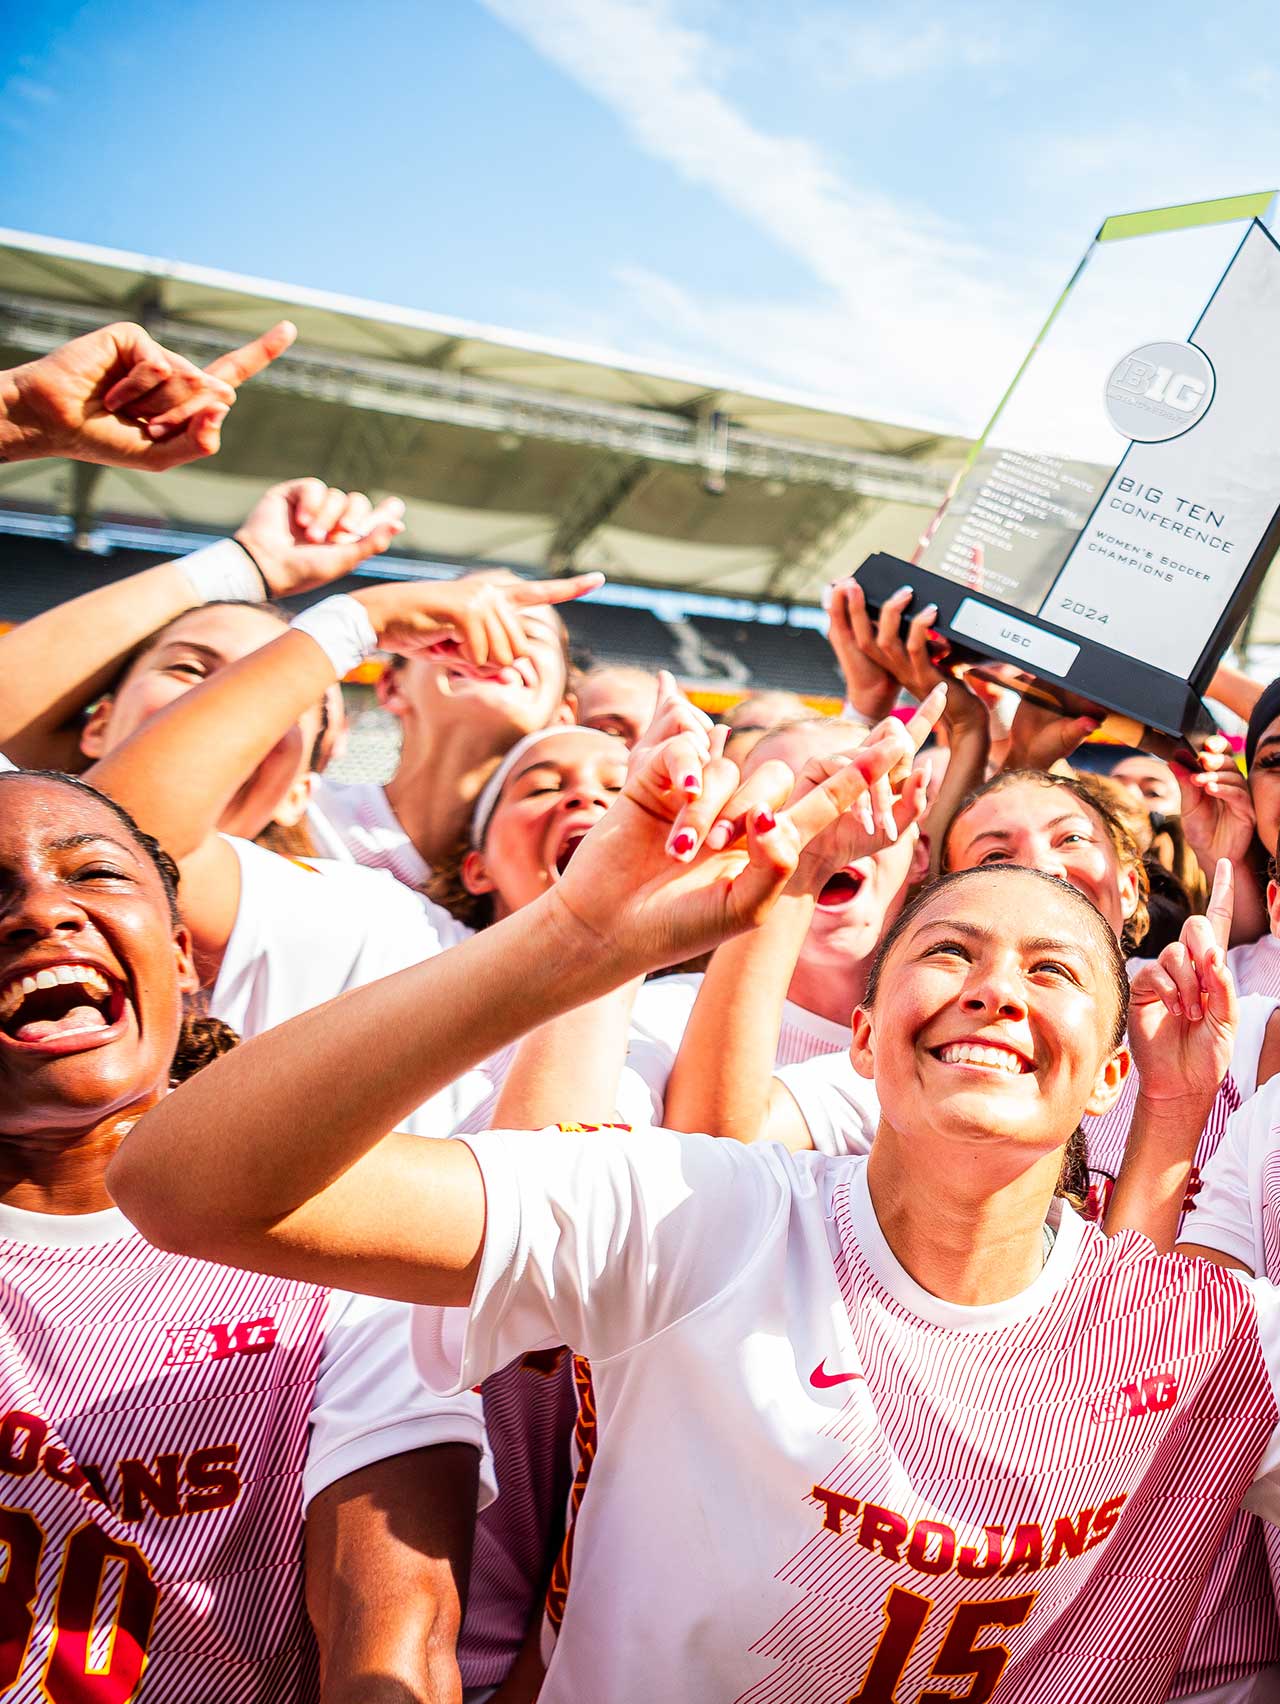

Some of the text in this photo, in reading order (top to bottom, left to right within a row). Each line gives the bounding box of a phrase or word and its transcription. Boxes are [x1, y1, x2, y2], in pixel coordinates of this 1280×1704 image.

[968, 505, 1040, 540] PENN STATE
[979, 487, 1048, 520] OHIO STATE
[1118, 477, 1225, 528] BIG TEN
[1109, 498, 1235, 554] CONFERENCE
[1088, 543, 1175, 583] CHAMPIONS
[1096, 530, 1211, 582] WOMEN'S SOCCER
[1060, 598, 1110, 624] 2024
[1000, 628, 1032, 648] USC
[811, 1485, 1129, 1580] TROJANS
[846, 1583, 1041, 1704] 15
